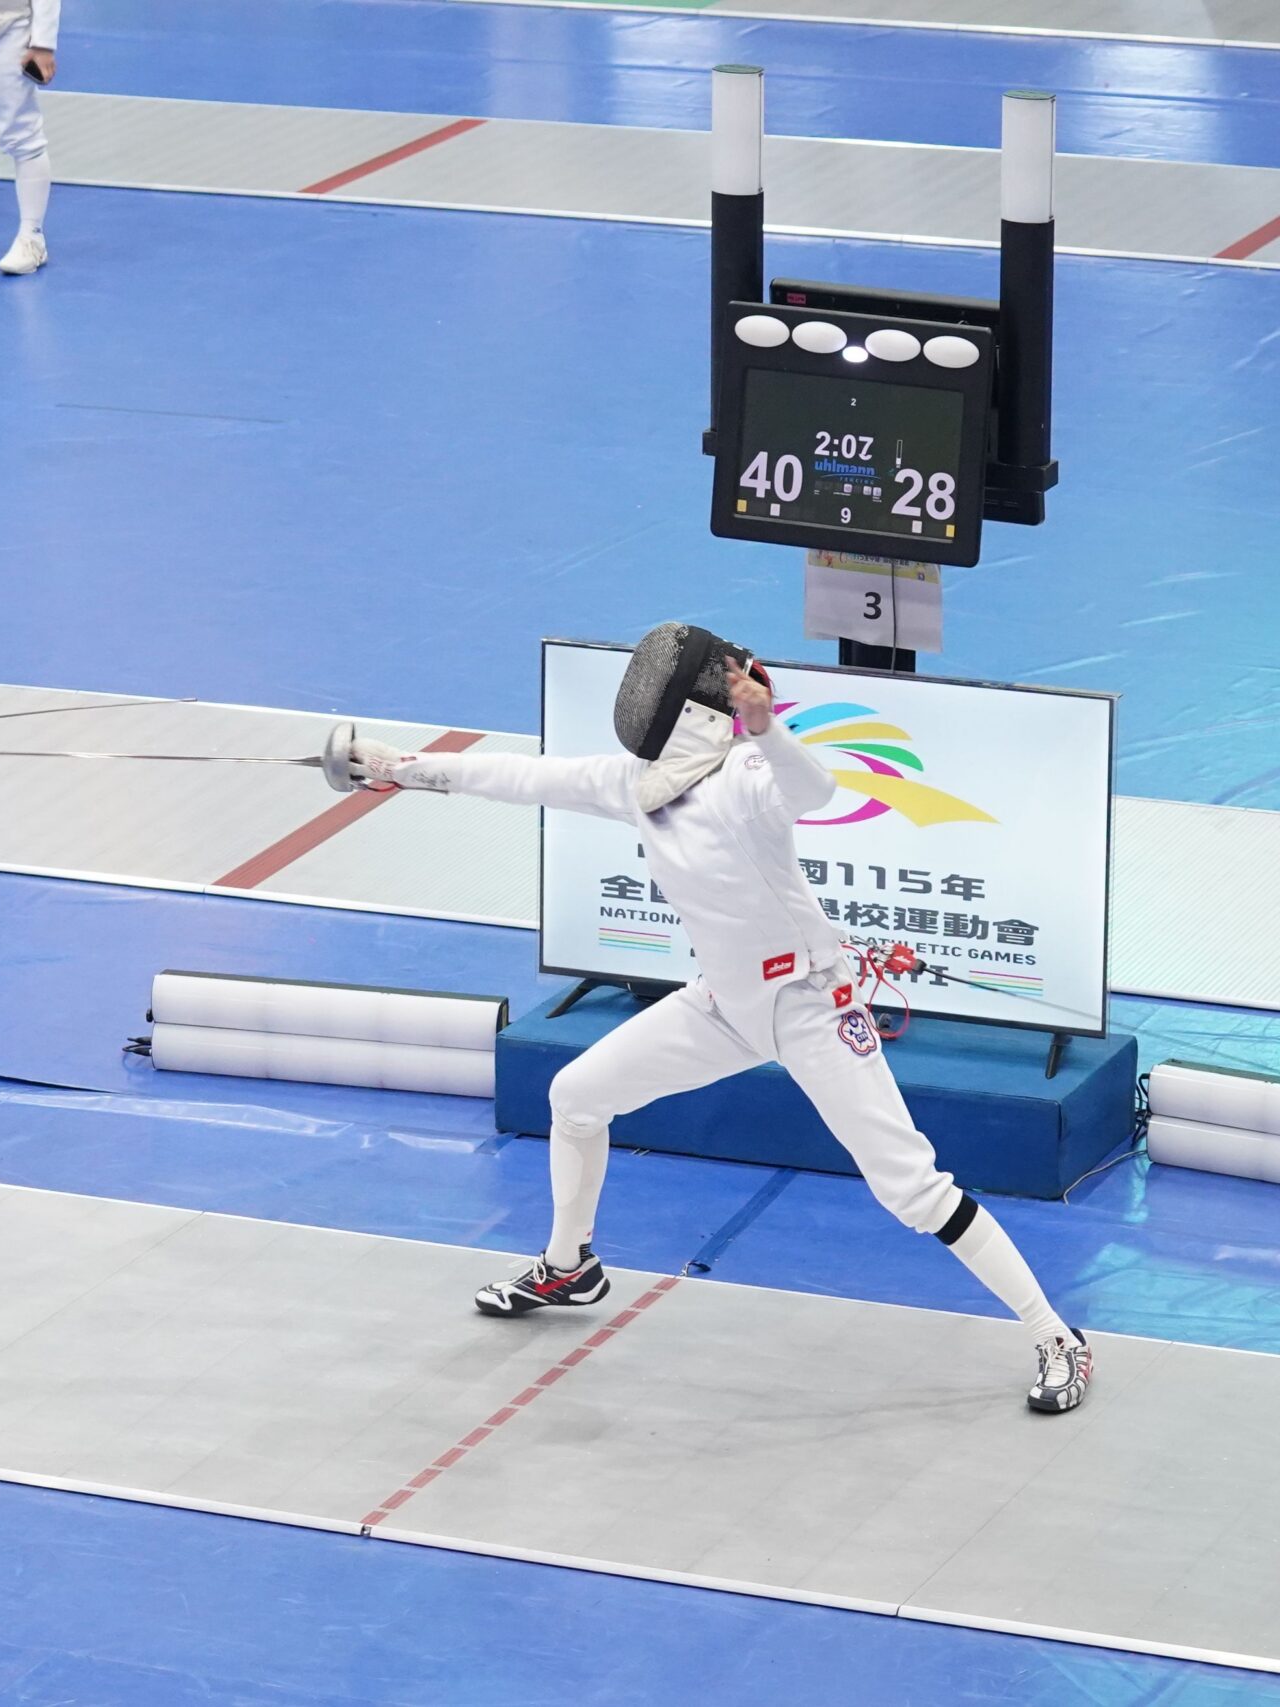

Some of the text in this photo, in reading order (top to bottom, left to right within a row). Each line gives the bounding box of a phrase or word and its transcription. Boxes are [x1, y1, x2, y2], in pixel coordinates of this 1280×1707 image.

[850, 398, 857, 406] 2
[814, 431, 874, 461] 2:07
[739, 451, 804, 502] 40
[814, 458, 876, 476] uhlmann
[891, 468, 956, 521] 28
[840, 507, 852, 524] 9
[863, 591, 882, 620] 3
[600, 906, 682, 925] NATION
[968, 948, 1037, 966] GAMES
